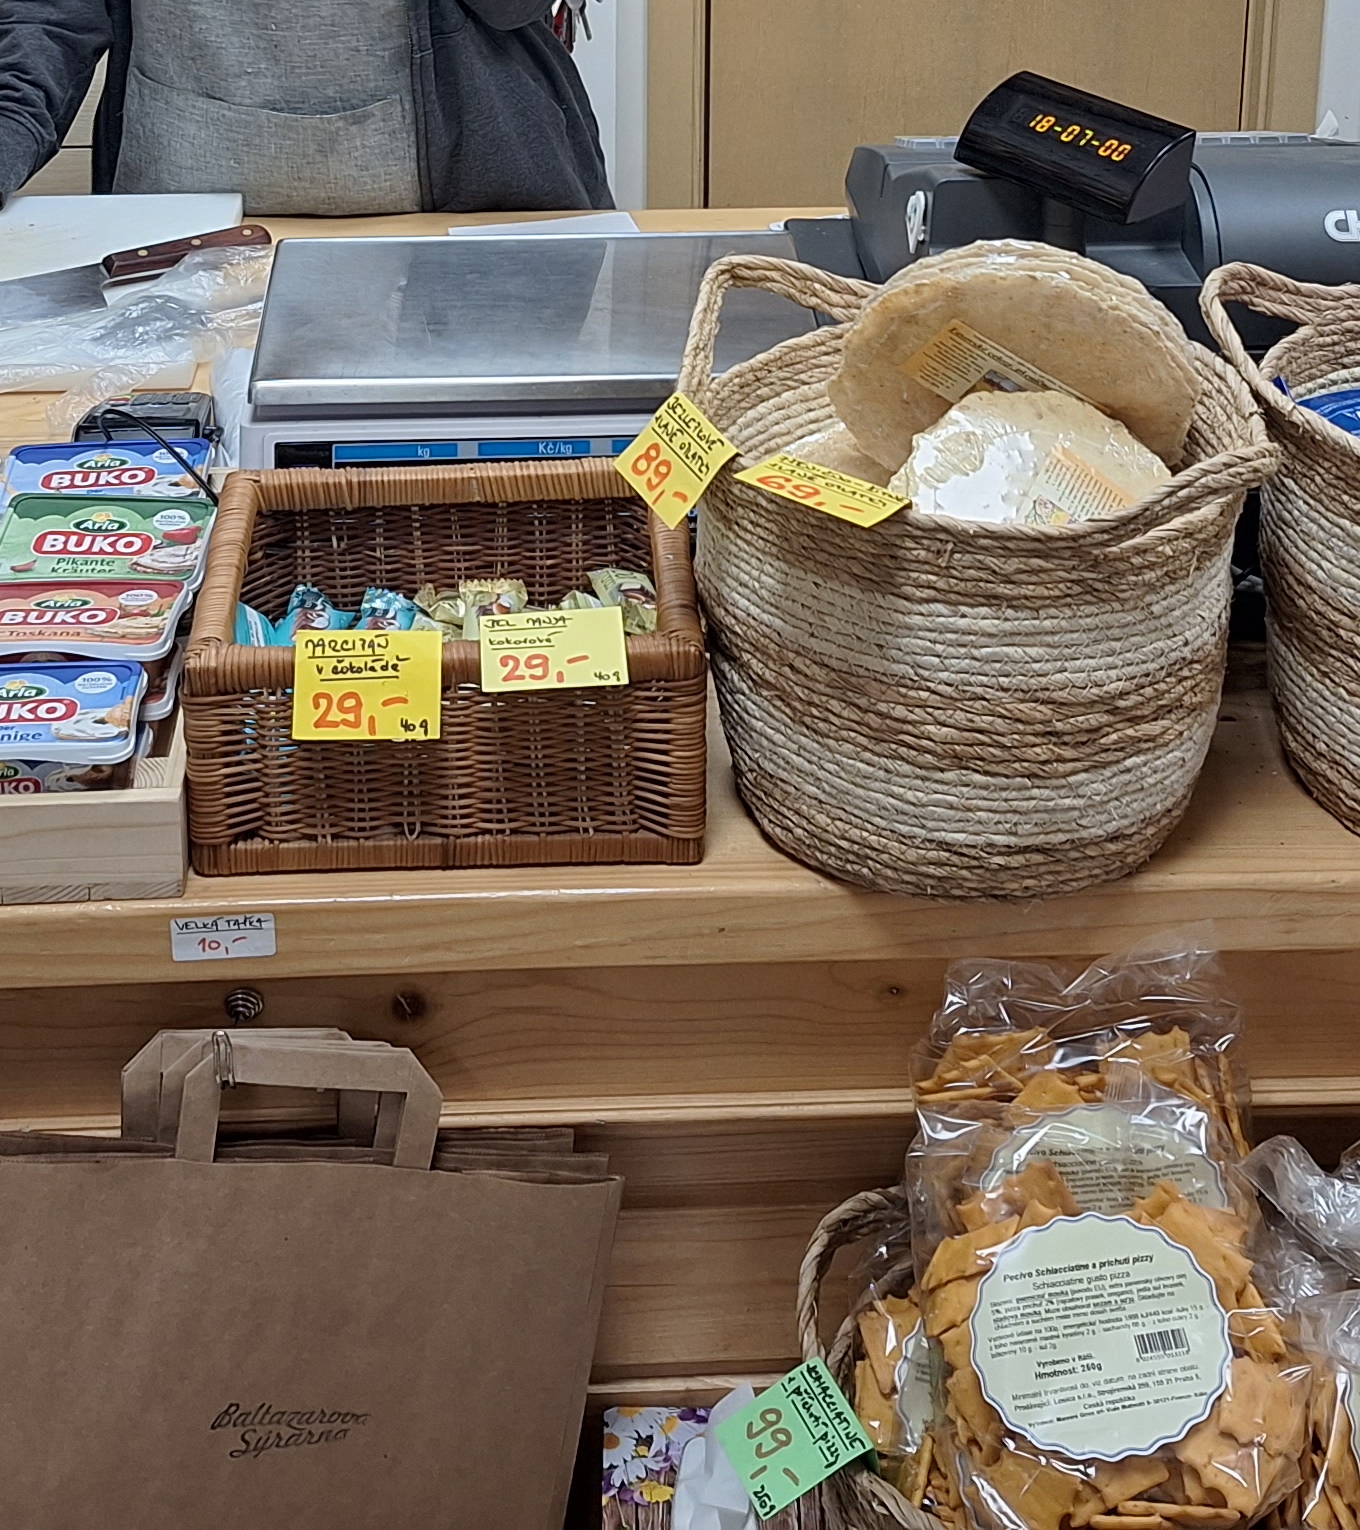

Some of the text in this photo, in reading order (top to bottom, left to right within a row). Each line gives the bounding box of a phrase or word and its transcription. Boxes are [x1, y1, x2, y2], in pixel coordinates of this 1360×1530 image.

[1028, 111, 1133, 163] 18-07-00
[416, 446, 432, 459] kg
[538, 440, 574, 457] Kč/kg
[83, 457, 124, 469] Arla
[631, 441, 689, 505] 89,-
[48, 469, 148, 488] BUKO
[755, 474, 865, 513] 69,-
[79, 519, 121, 531] Arla
[40, 533, 145, 553] BUKO
[56, 557, 117, 569] Pikante
[6, 628, 82, 638] Toskana
[499, 653, 590, 683] 29,-
[312, 690, 409, 736] 29,-
[197, 934, 247, 956] 10,-
[210, 1402, 372, 1431] Baltazarova
[746, 1407, 800, 1486] 99,-
